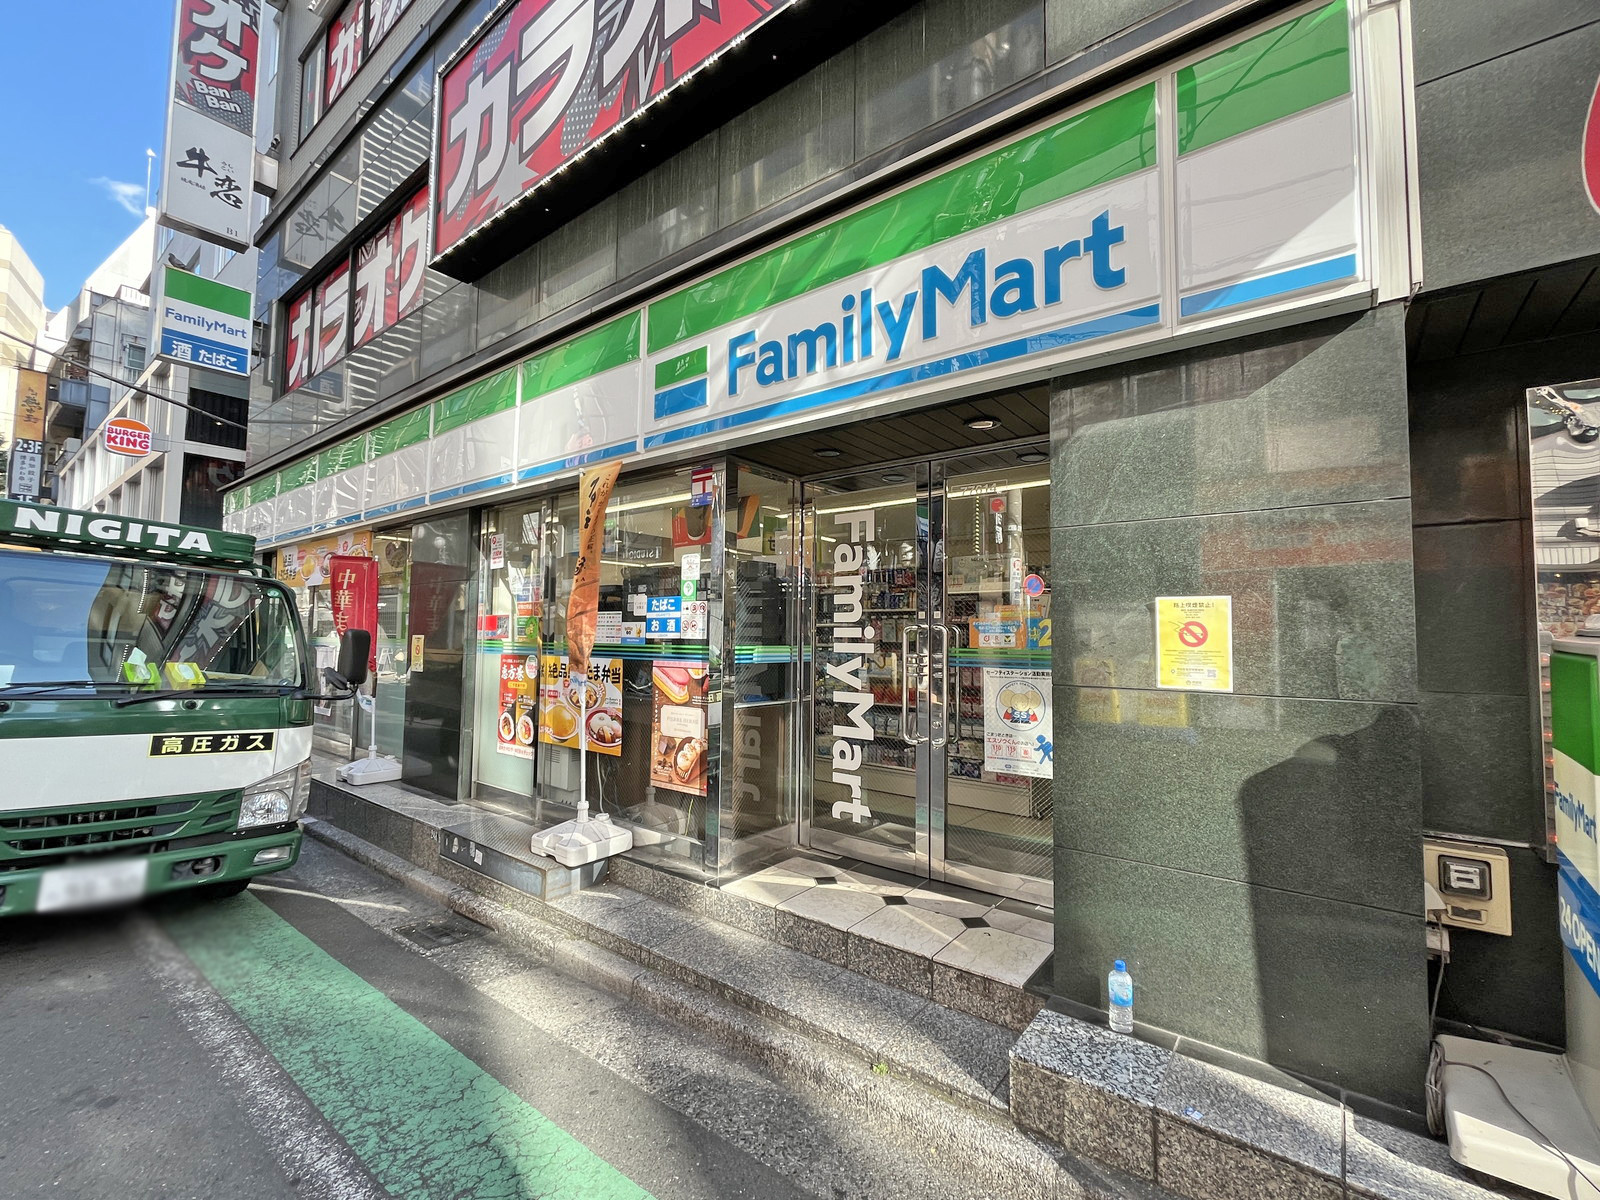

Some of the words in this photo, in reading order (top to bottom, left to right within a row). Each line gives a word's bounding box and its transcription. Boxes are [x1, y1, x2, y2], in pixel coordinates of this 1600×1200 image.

[193, 79, 231, 99] Ban
[205, 94, 242, 114] Ban
[226, 227, 238, 237] B1
[728, 208, 1128, 397] FamilyMart
[165, 307, 247, 338] FamilyMart
[171, 341, 192, 360] 酒
[198, 349, 238, 370] たばこ
[106, 435, 150, 450] KING
[107, 426, 150, 440] BURGER
[14, 507, 212, 553] NIGITA
[651, 598, 676, 612] たばこ
[501, 664, 525, 681] 恵方巻
[826, 509, 875, 824] FamilyMart
[1013, 711, 1028, 719] SS
[161, 735, 266, 755] 高圧ガス
[1554, 781, 1597, 845] FamilyMart
[1560, 896, 1572, 935] 24
